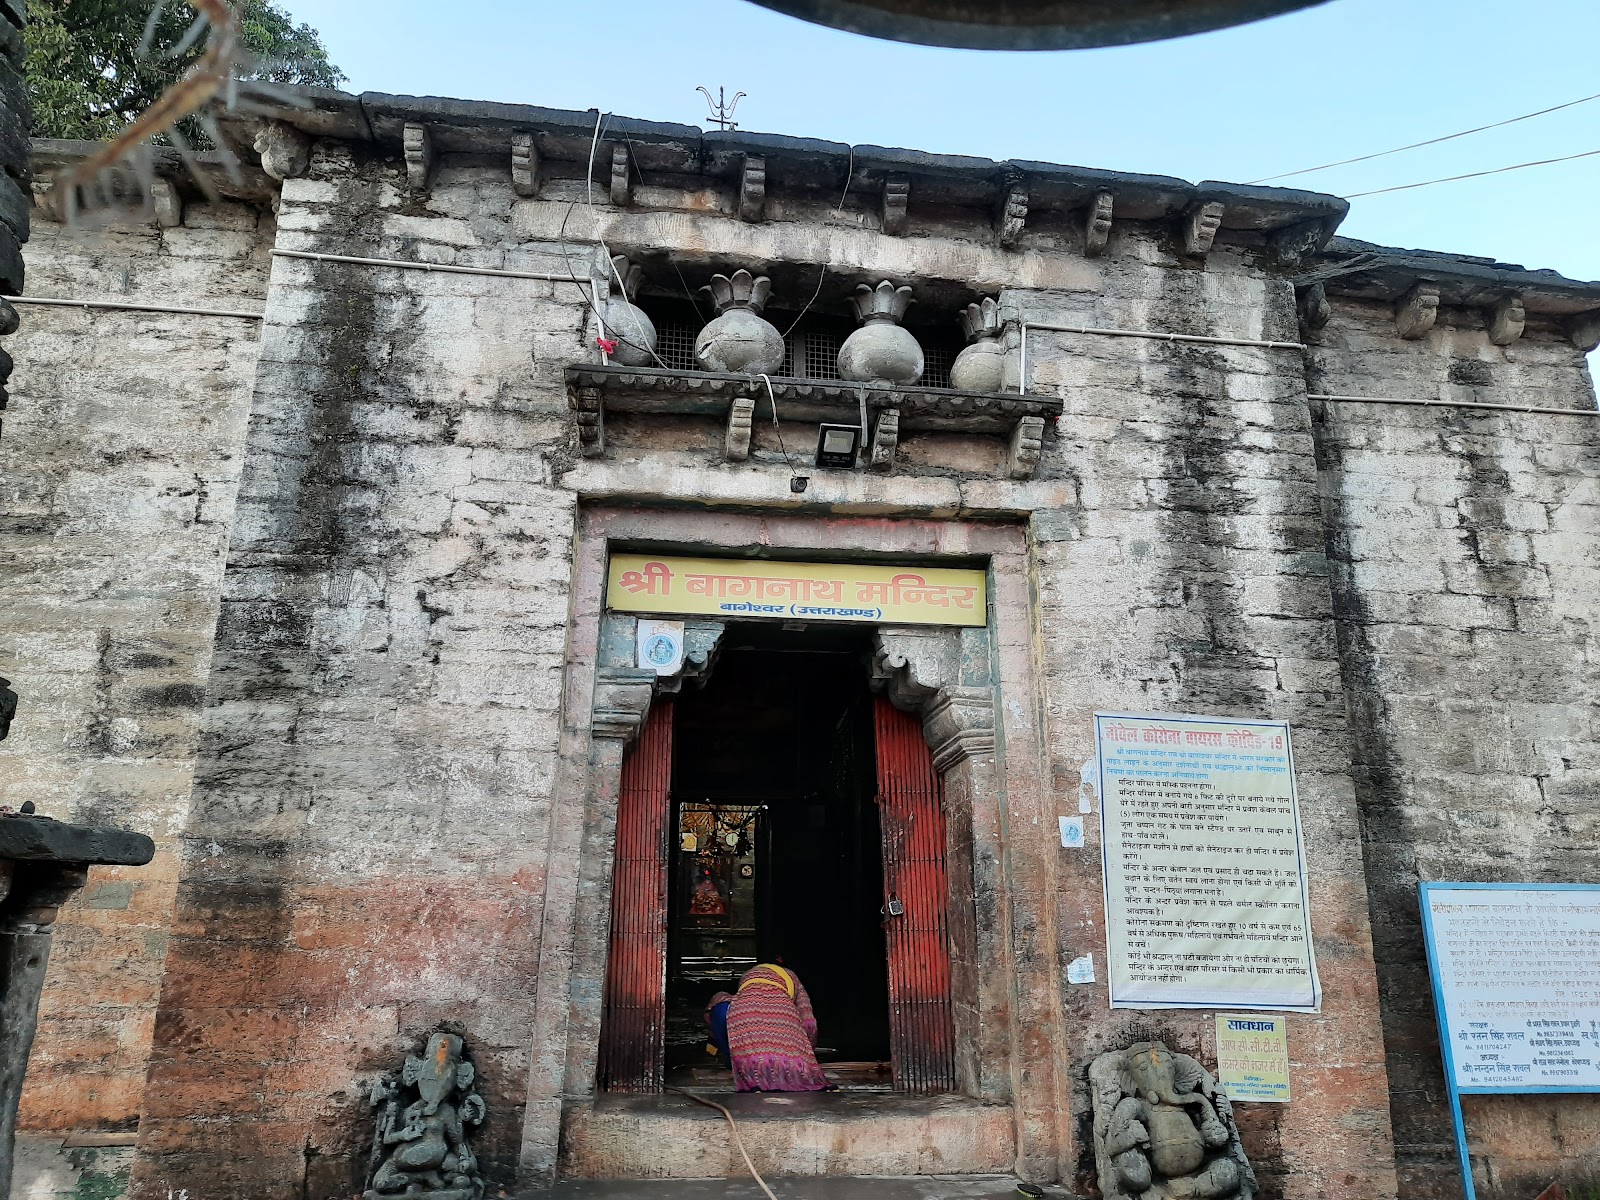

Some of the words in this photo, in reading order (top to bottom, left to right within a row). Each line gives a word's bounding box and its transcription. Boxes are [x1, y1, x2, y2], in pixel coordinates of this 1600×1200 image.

[619, 562, 674, 596] श्री
[685, 574, 845, 603] बागनाथ
[855, 574, 977, 609] मन्दिर
[720, 602, 786, 613] बागेश्वर
[790, 603, 882, 620] (उत्तराखण्ड)
[1227, 1019, 1274, 1032] सावधान
[1506, 1032, 1525, 1041] रावल
